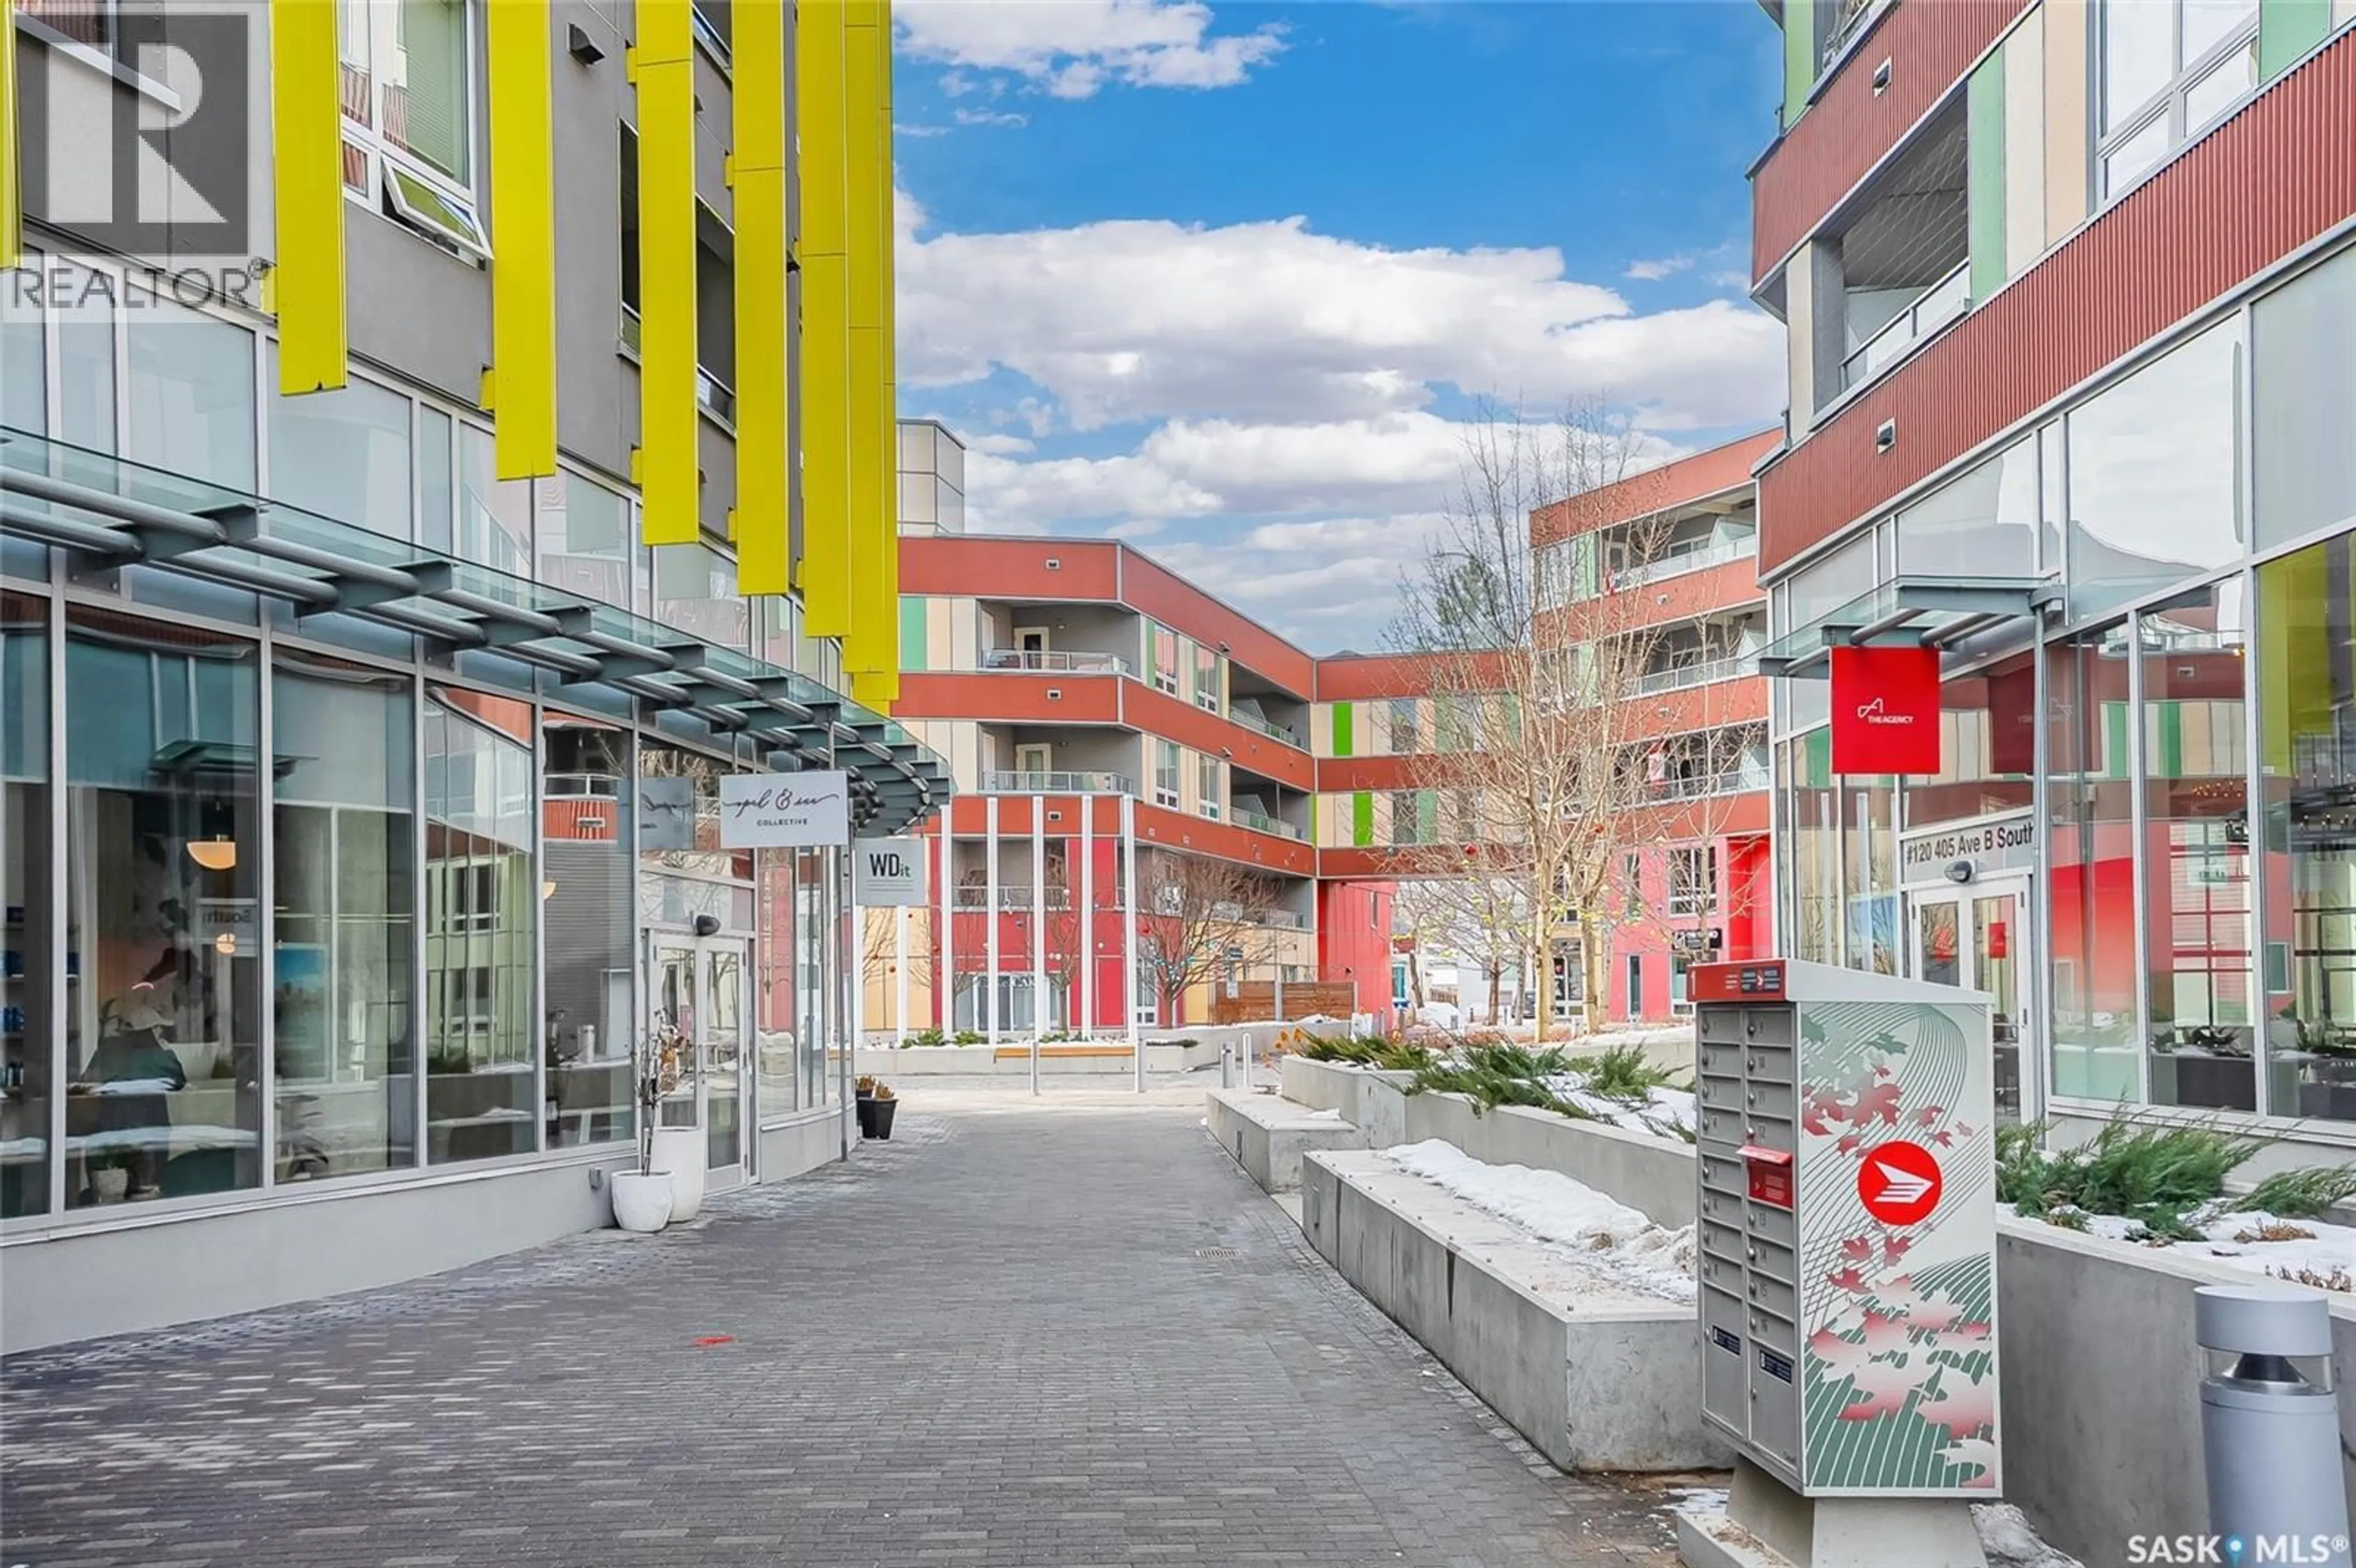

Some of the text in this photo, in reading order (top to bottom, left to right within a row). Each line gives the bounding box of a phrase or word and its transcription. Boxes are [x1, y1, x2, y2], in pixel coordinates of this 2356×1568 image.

[776, 788, 793, 811] &
[756, 817, 809, 827] COLLECTIVE
[1906, 841, 1932, 865] #120
[1934, 837, 1955, 859] 405
[1957, 835, 1981, 856] Ave
[1984, 830, 1993, 851] B
